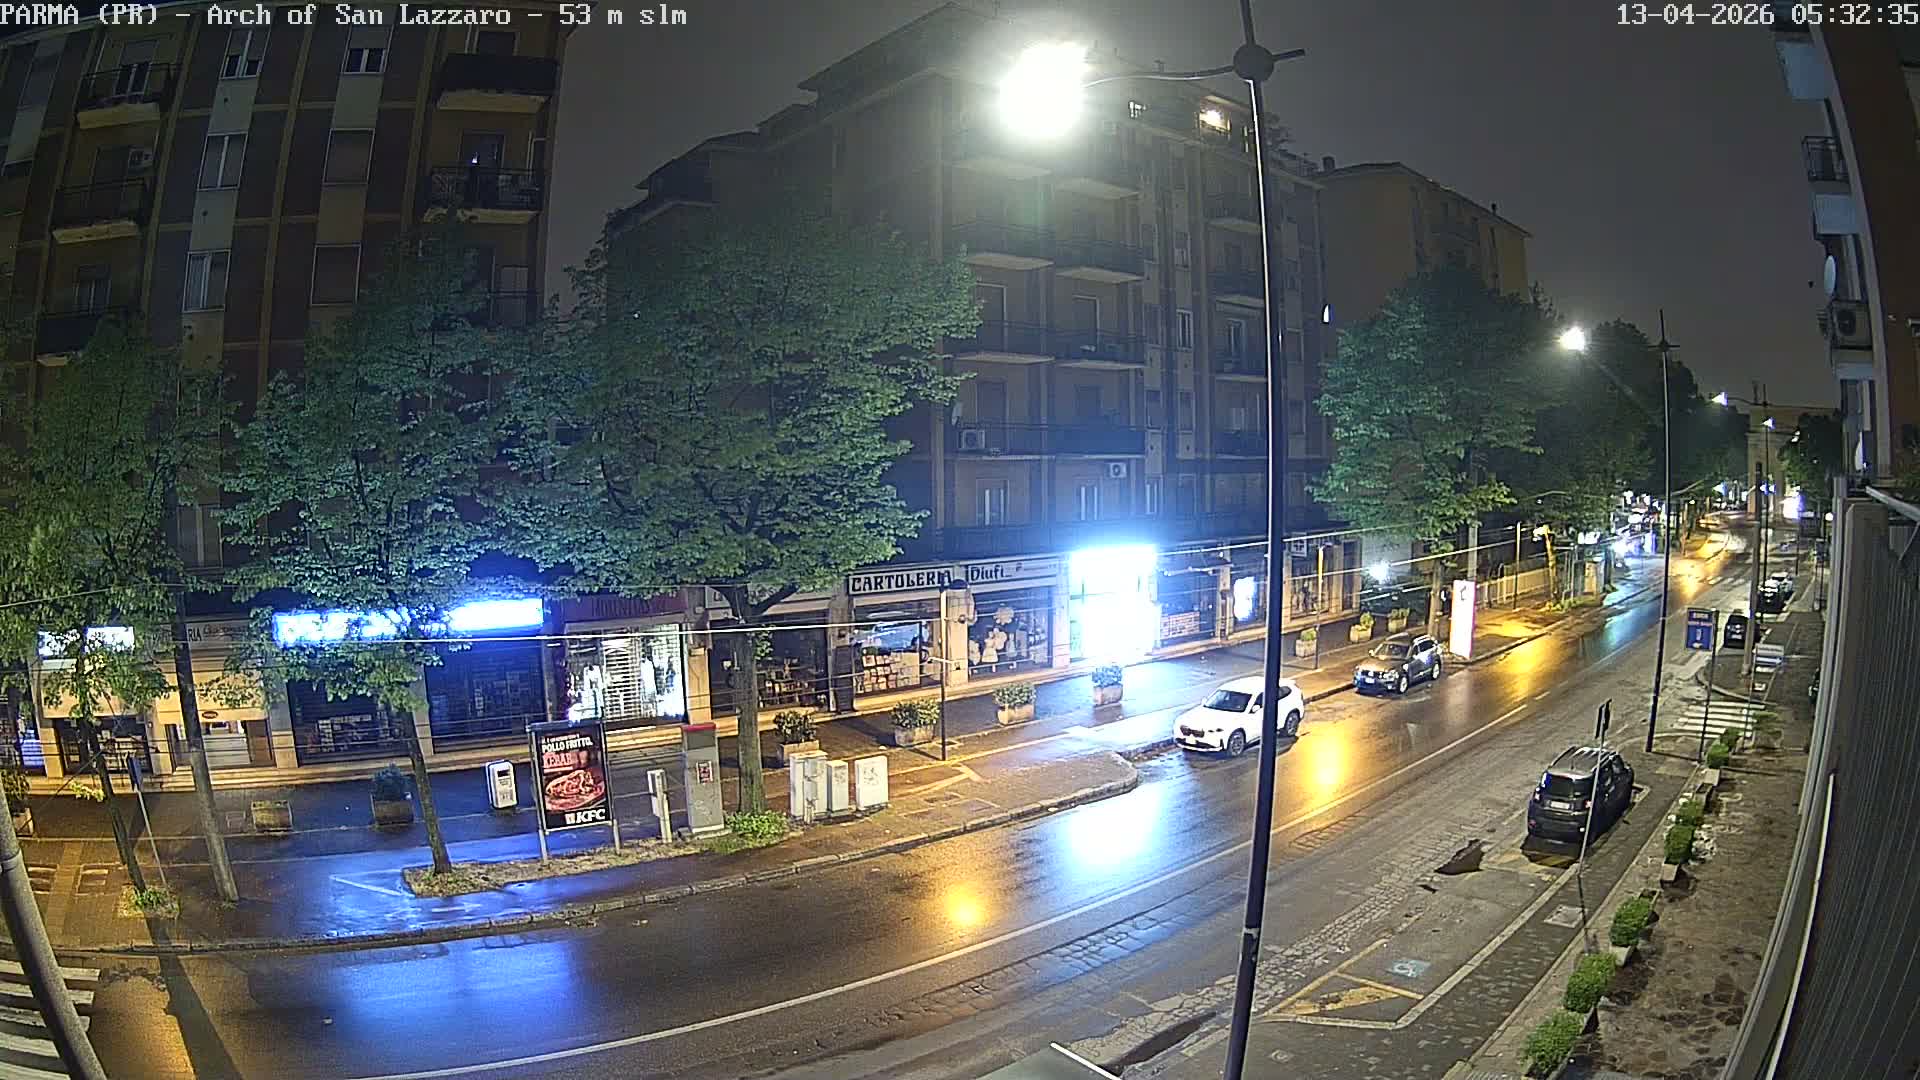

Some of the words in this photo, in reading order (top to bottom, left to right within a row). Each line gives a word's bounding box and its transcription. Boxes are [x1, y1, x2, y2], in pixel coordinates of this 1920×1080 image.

[851, 569, 952, 592] CARTOLERIA
[542, 742, 565, 753] POLLO
[576, 809, 605, 823] KFC
